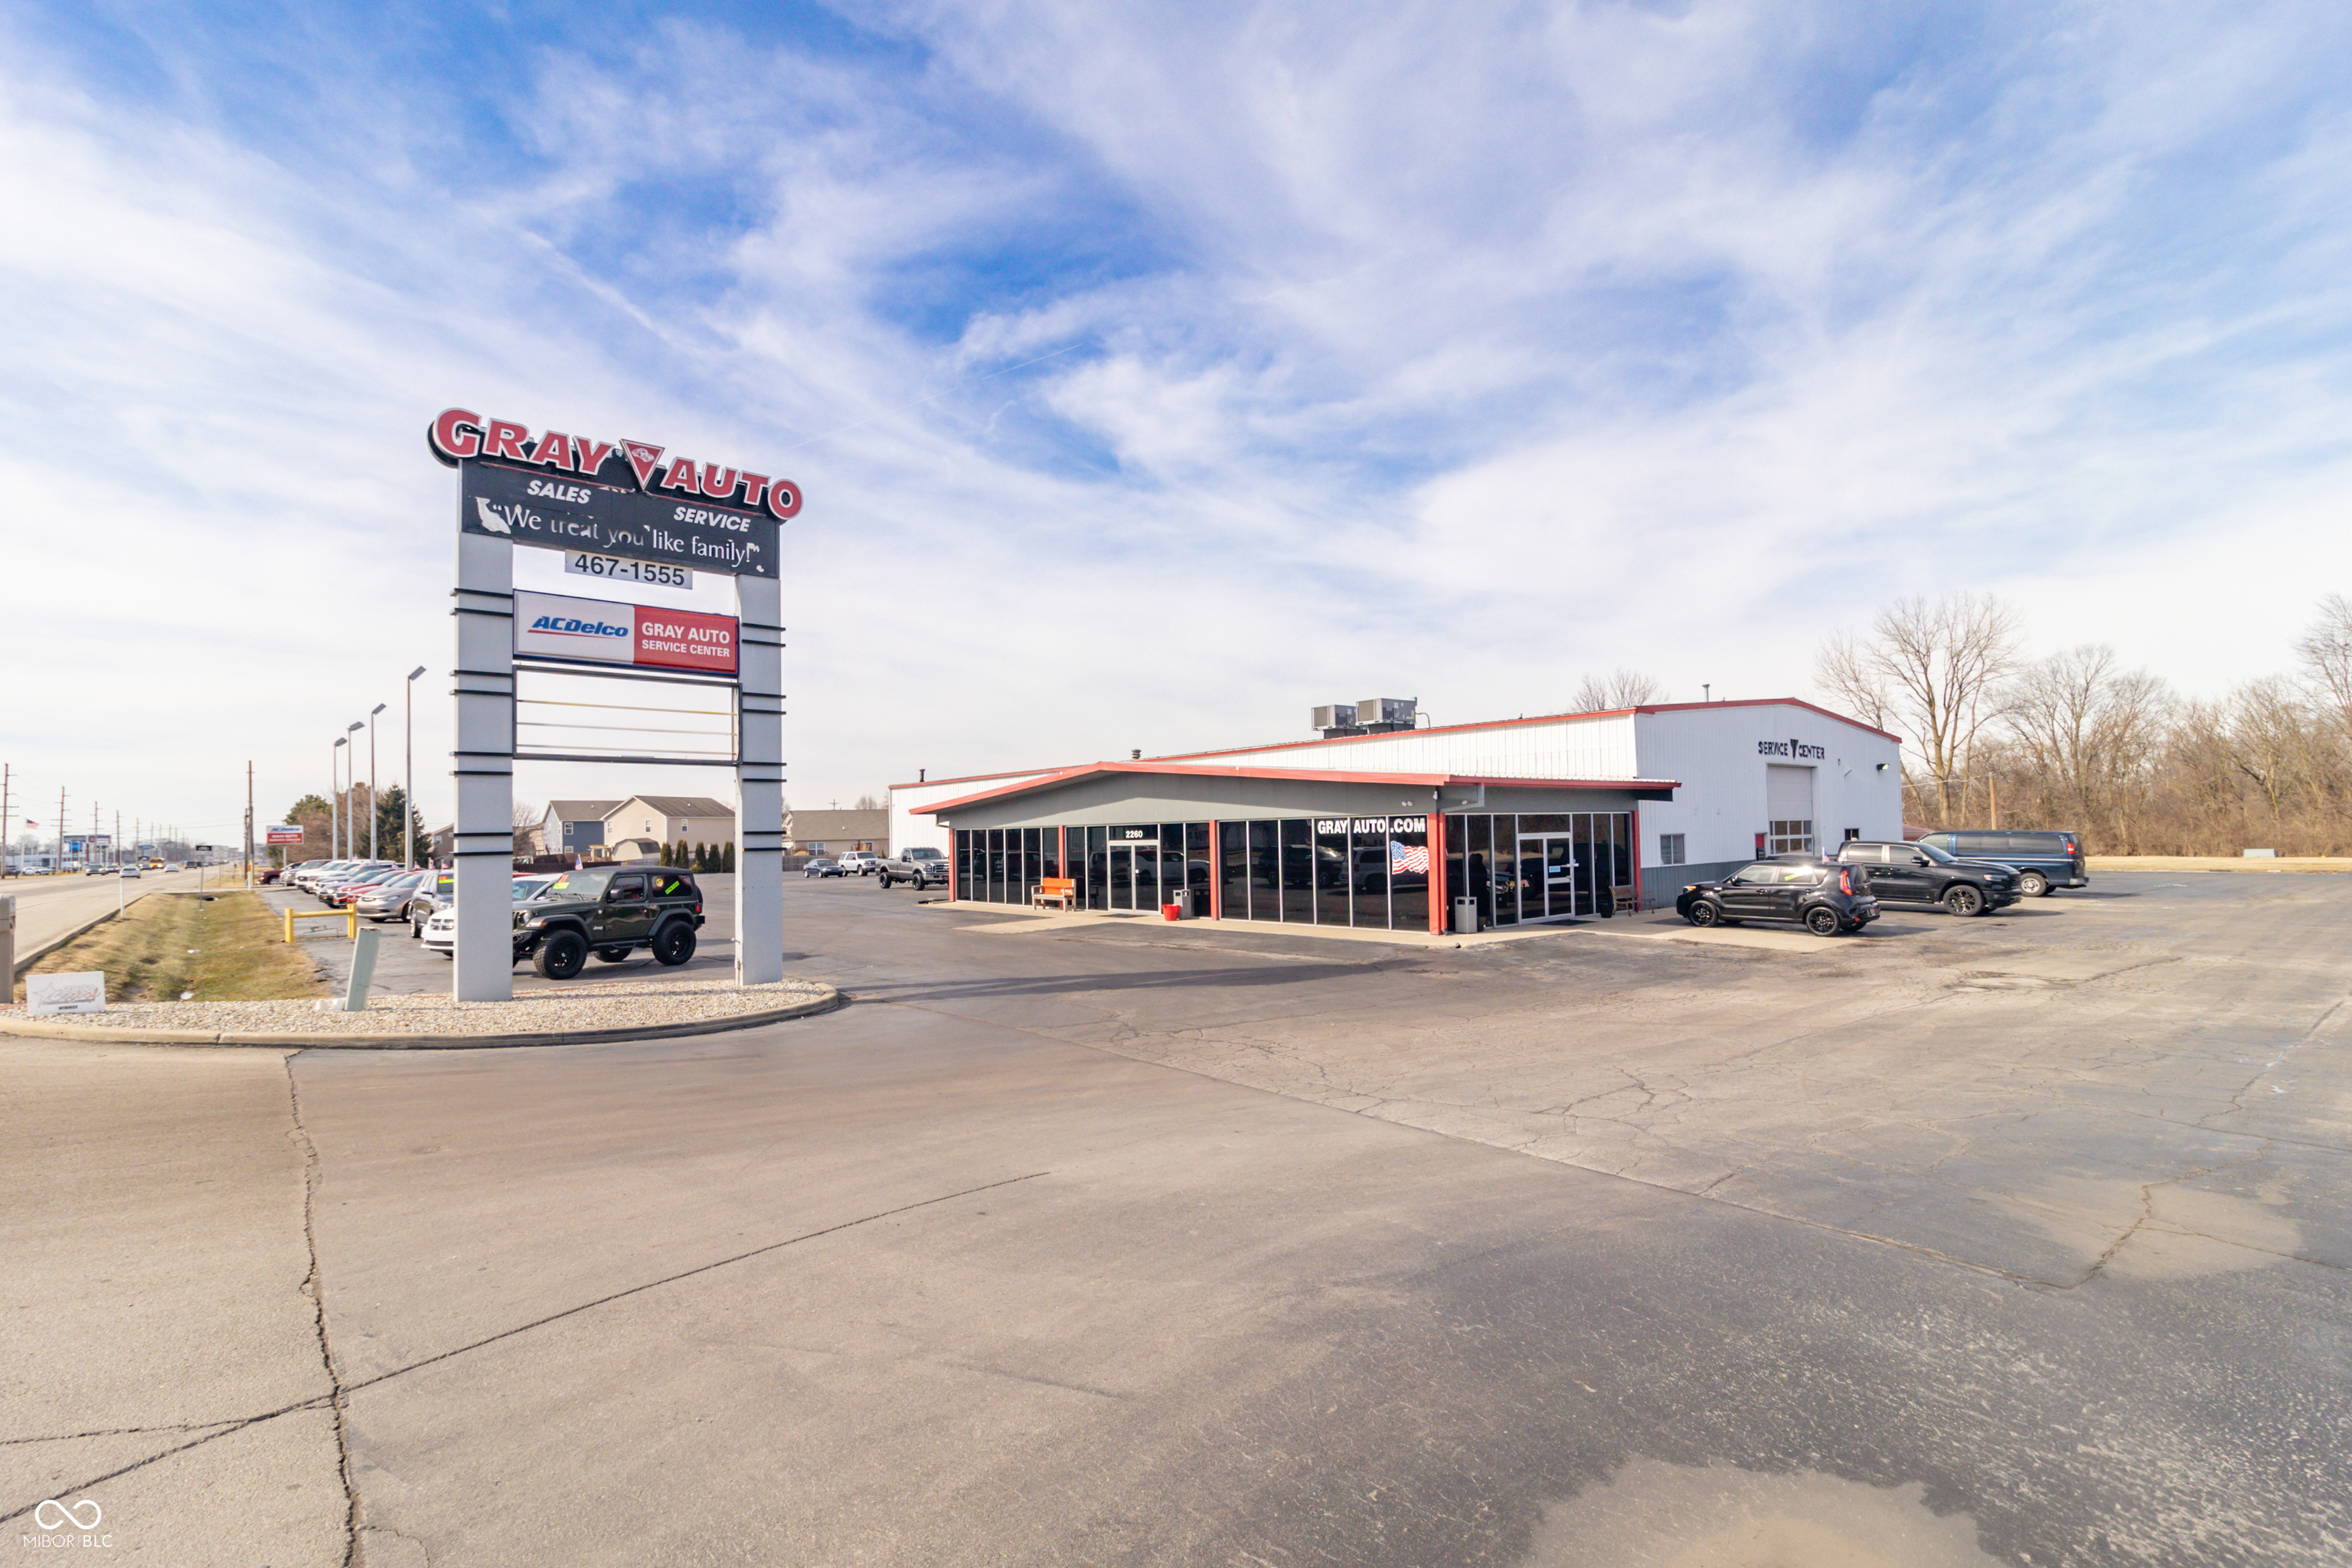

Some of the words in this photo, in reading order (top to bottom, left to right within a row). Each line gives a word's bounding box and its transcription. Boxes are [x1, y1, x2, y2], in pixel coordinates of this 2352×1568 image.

[433, 407, 616, 475] GRAY
[660, 456, 804, 520] AUTO
[527, 479, 592, 505] SALES
[673, 506, 751, 532] SERVICE
[603, 528, 644, 548] you
[653, 529, 684, 552] like
[575, 554, 684, 586] 467-1555
[531, 616, 629, 637] ACDelco
[642, 622, 684, 639] GRAY
[688, 627, 730, 644] AUTO
[642, 639, 687, 653] SERVICE
[690, 645, 730, 657] CENTER
[1758, 740, 1788, 756] SERVICE
[1798, 744, 1824, 760] CENTER
[1125, 830, 1143, 838] 2260
[1317, 820, 1348, 834] GRAY
[1353, 818, 1386, 833] AUTO
